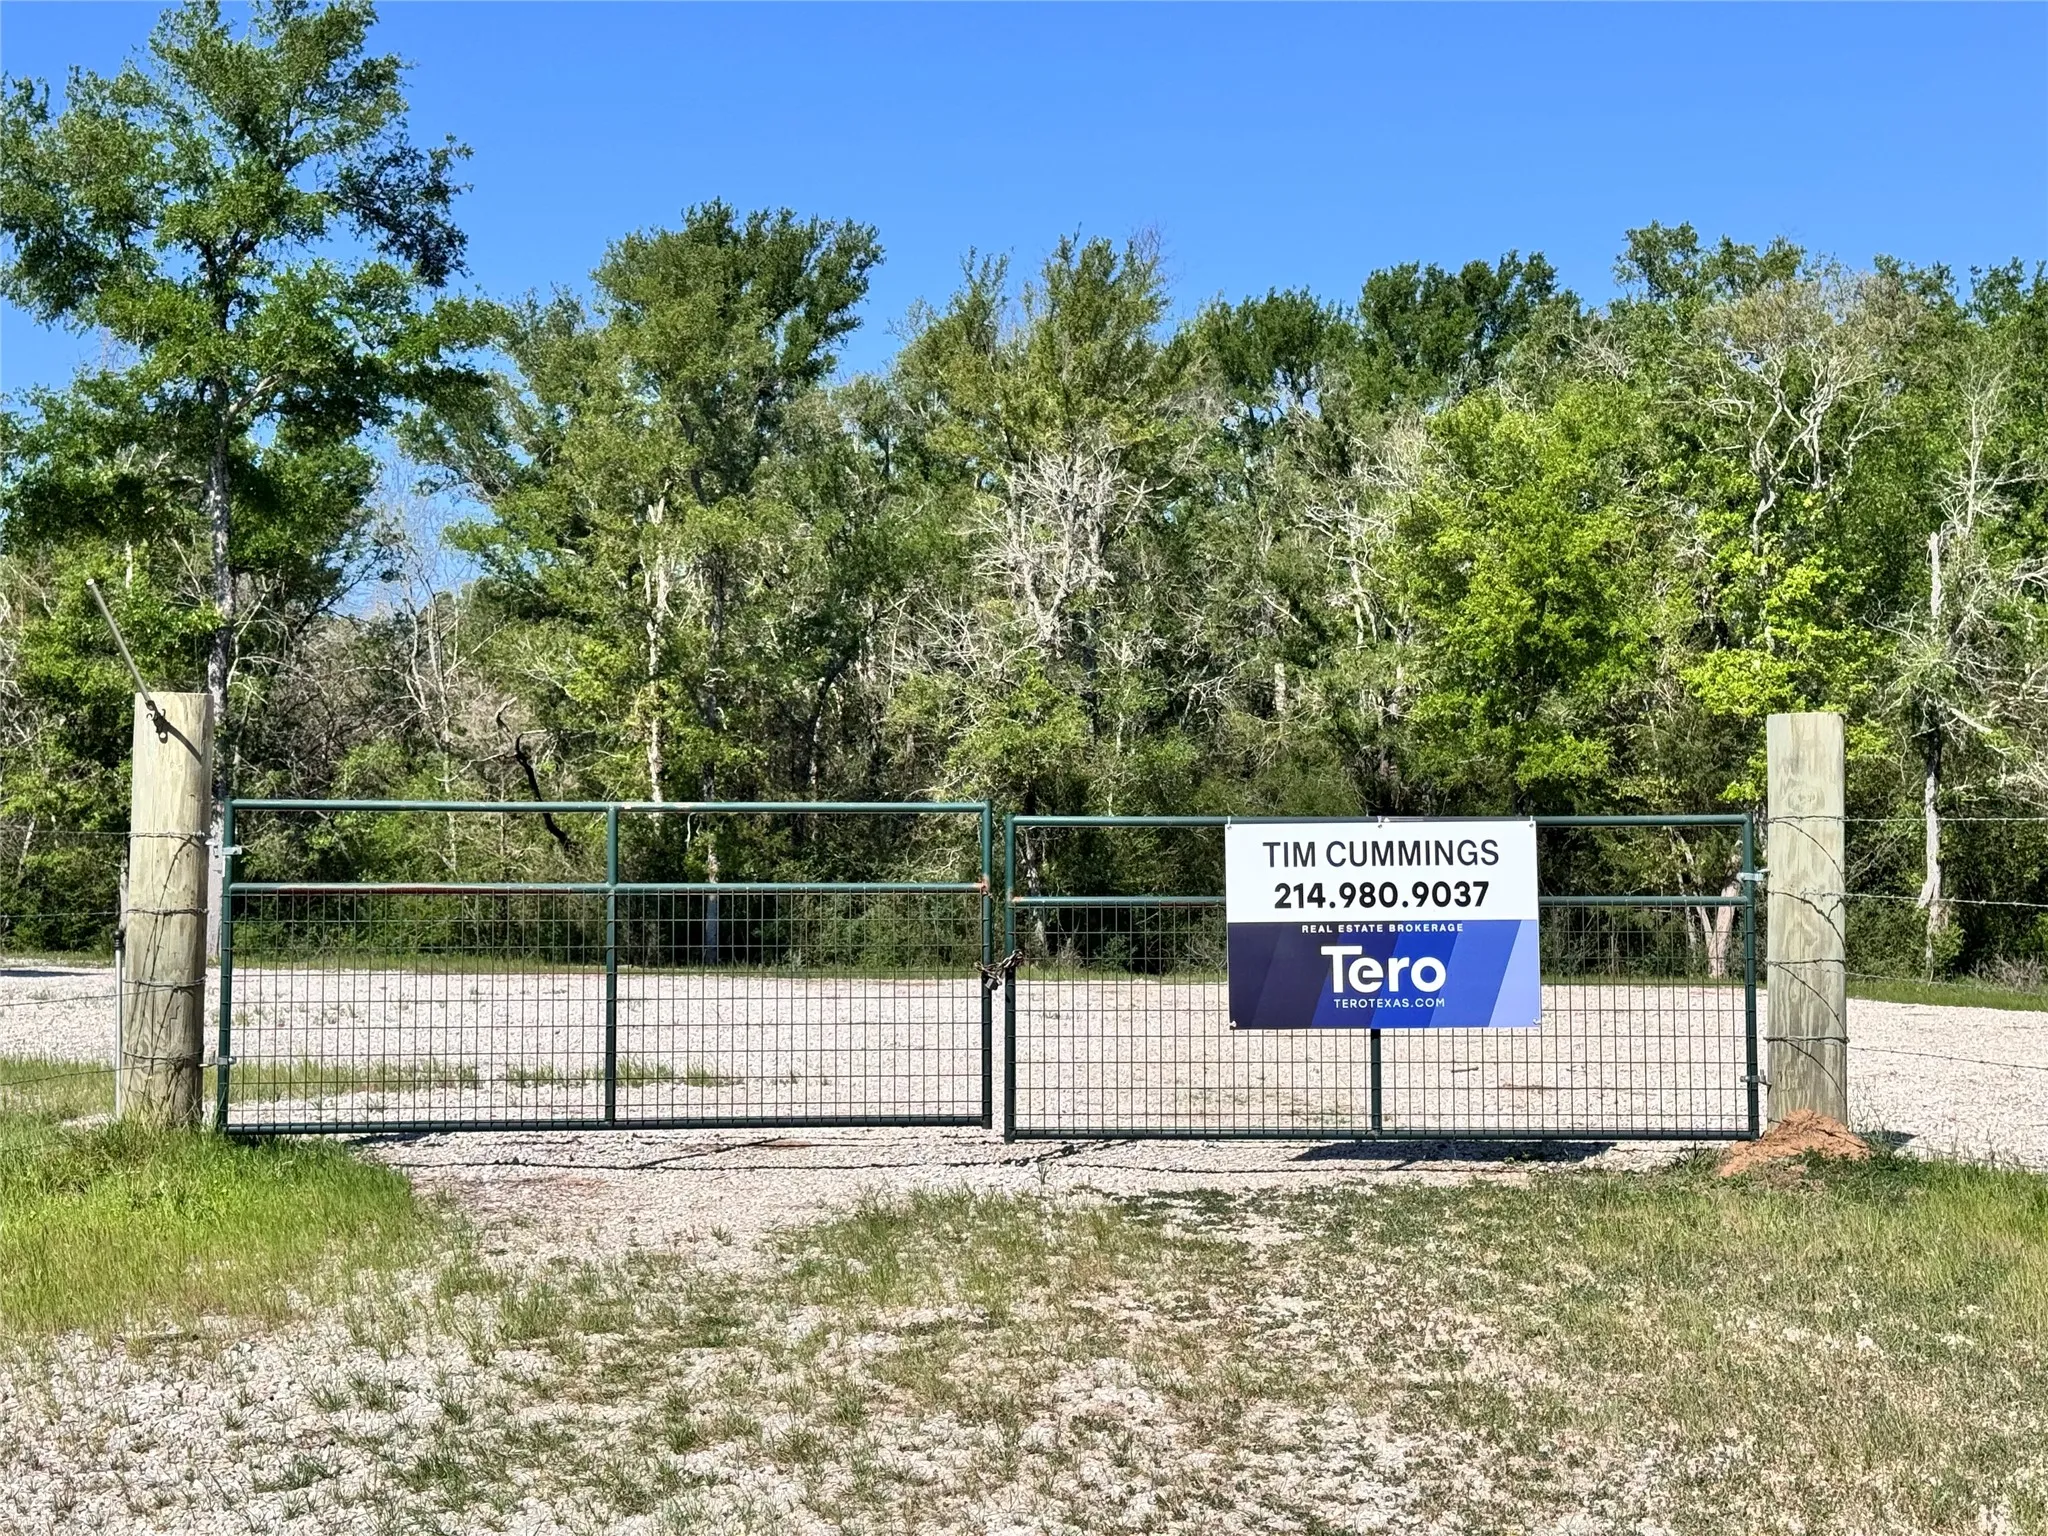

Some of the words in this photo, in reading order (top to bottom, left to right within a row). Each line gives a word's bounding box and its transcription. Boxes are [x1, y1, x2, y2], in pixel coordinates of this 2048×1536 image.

[1263, 841, 1316, 867] TIM
[1326, 839, 1499, 867] CUMMINGS
[1274, 881, 1489, 909] 214.980.9037
[1302, 924, 1332, 933] REAL
[1338, 924, 1383, 933] ESTATE
[1389, 923, 1464, 932] BROKERAGE
[1321, 945, 1446, 993] Tero
[1334, 997, 1445, 1008] TEROTEXAS.COM
